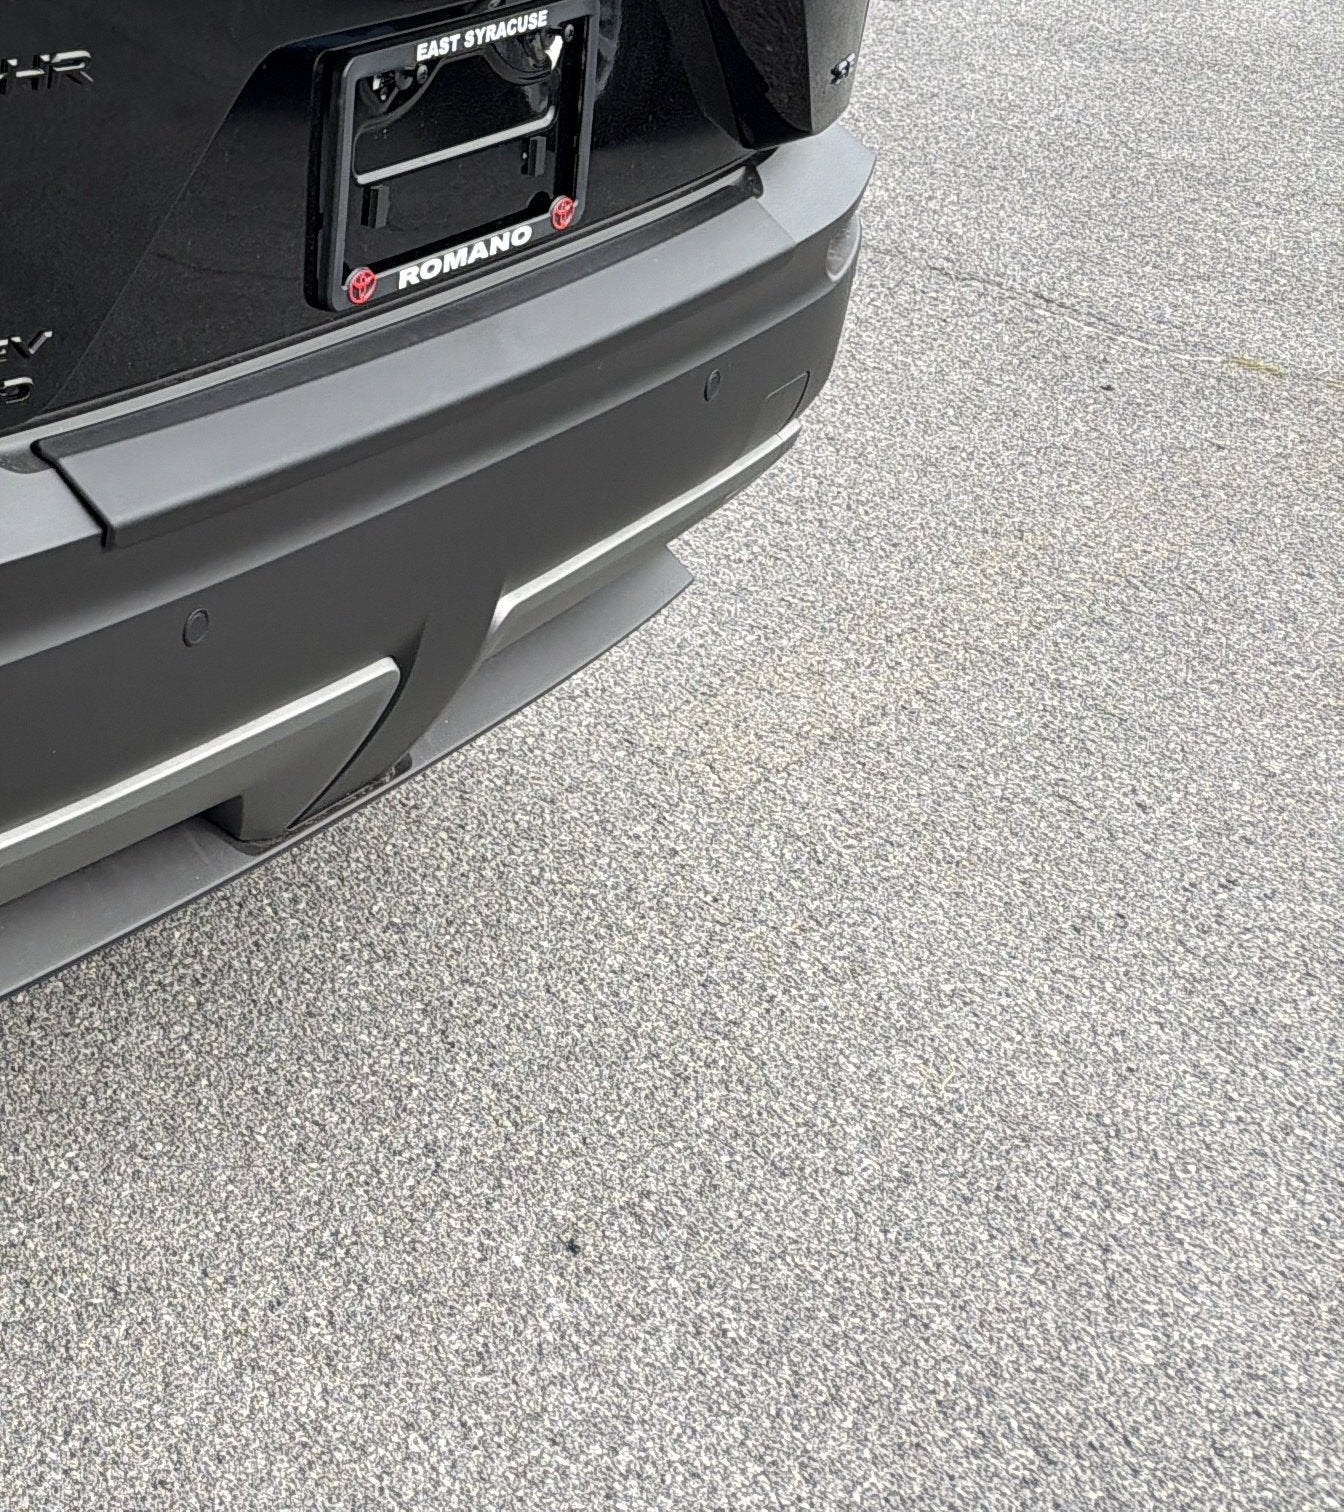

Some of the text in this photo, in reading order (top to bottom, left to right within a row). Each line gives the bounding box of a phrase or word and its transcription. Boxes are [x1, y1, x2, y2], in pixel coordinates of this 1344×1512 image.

[416, 9, 549, 62] EAST SYRACUSE
[398, 225, 533, 290] ROMANO
